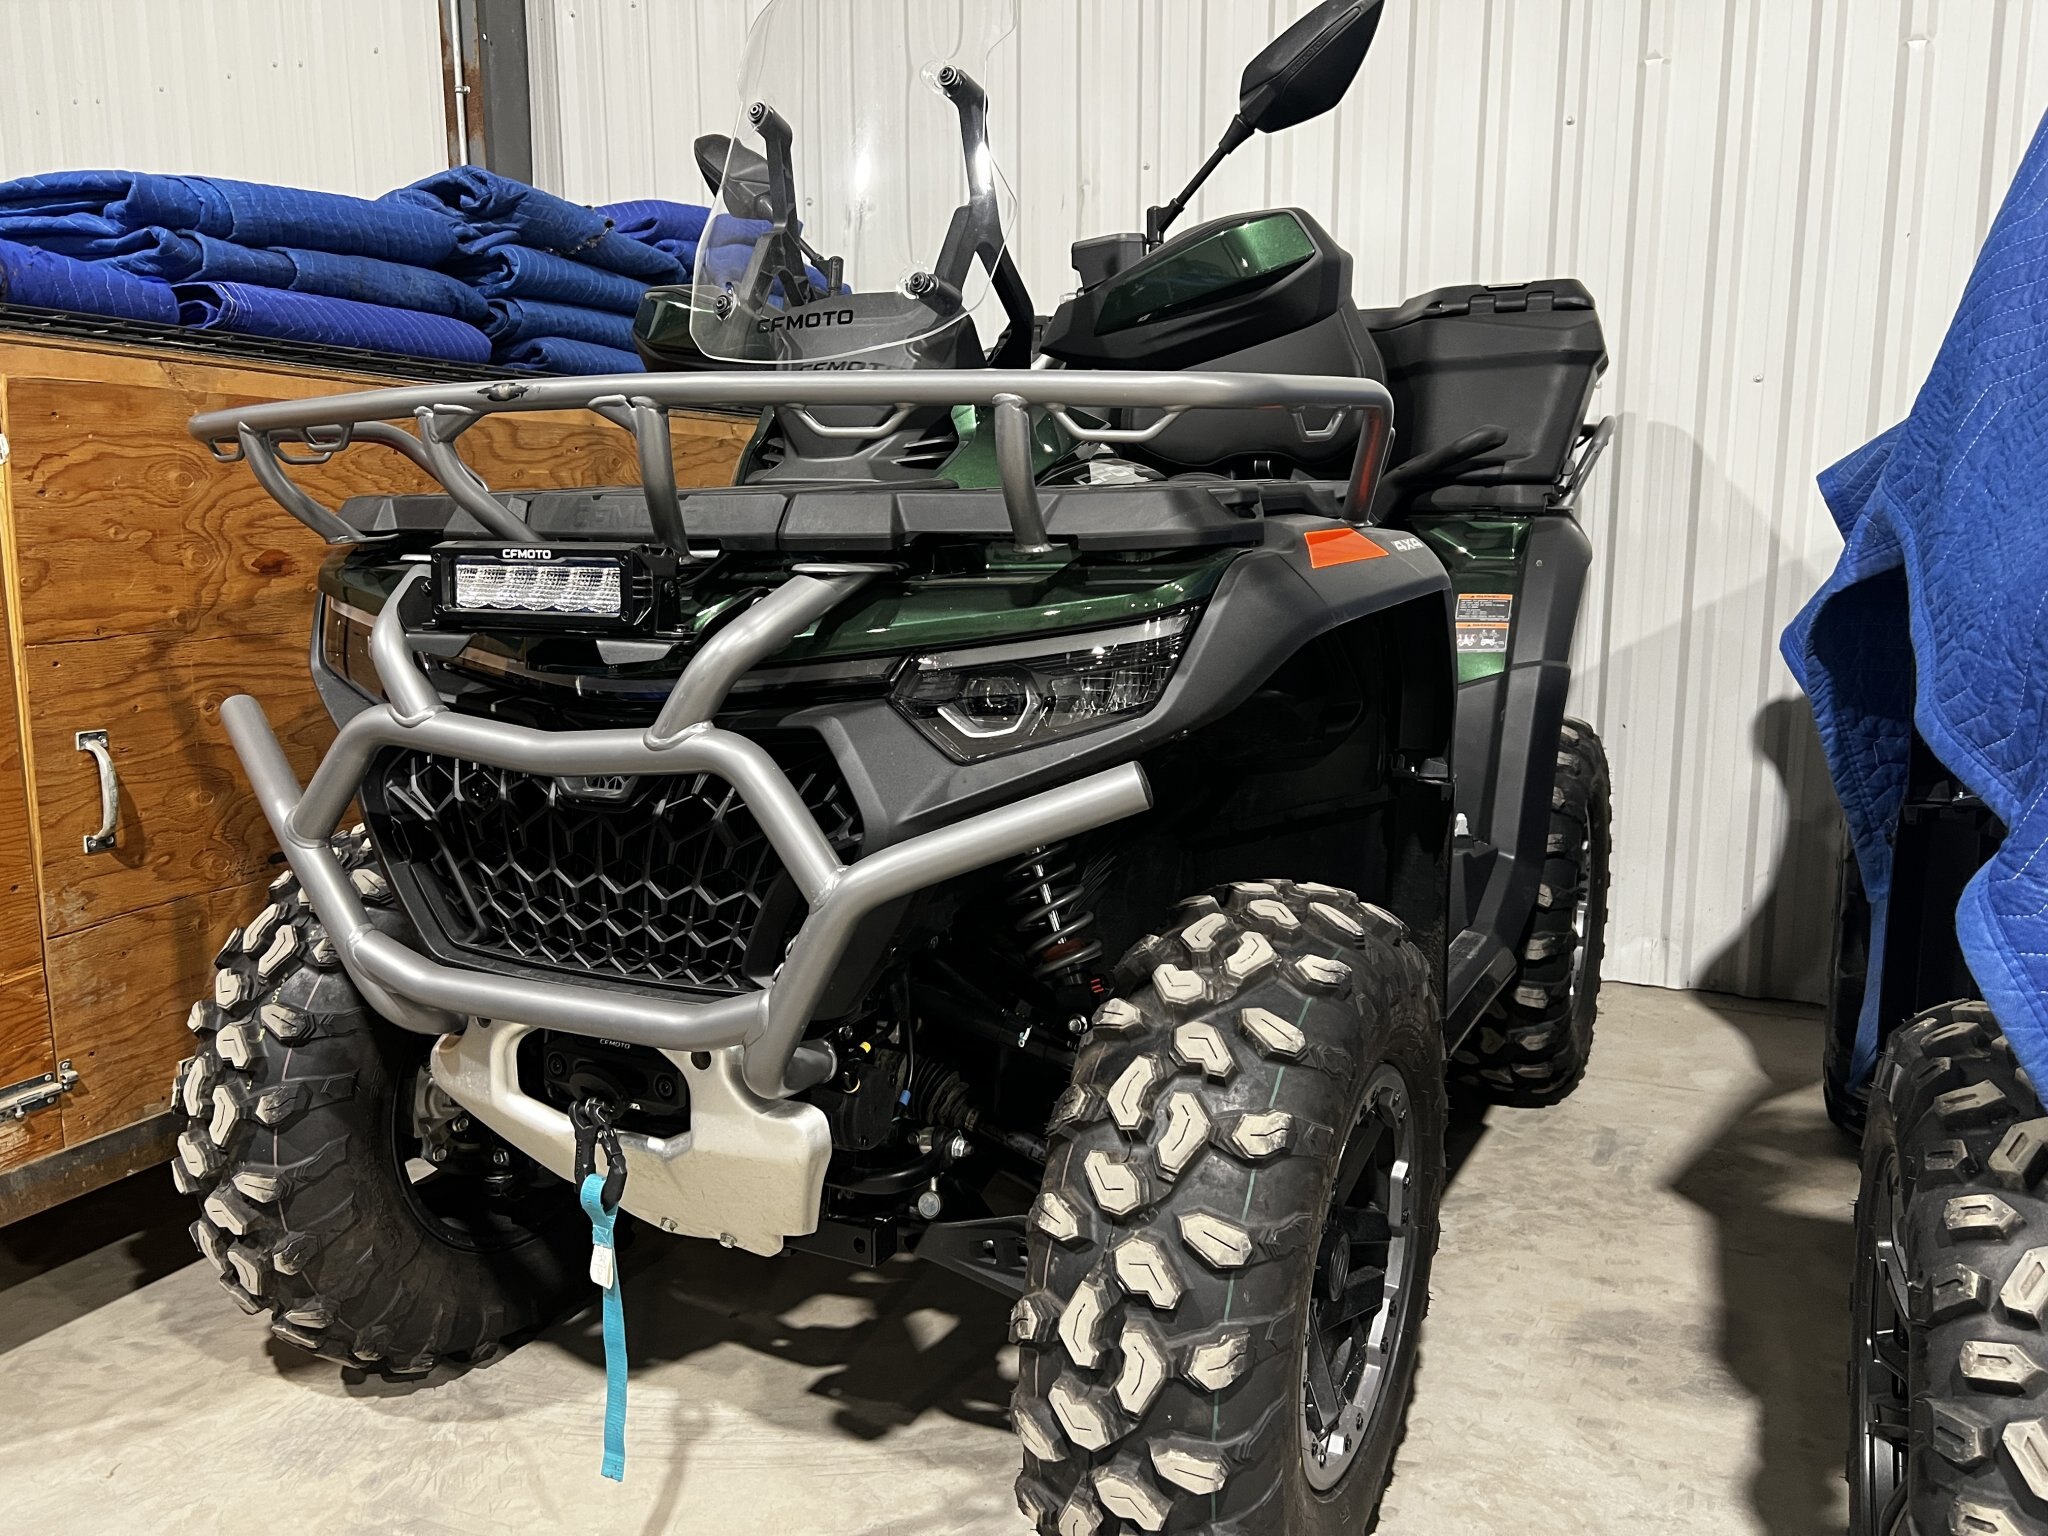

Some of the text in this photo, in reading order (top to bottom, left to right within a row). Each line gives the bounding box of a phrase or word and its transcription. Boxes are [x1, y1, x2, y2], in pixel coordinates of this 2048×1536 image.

[757, 309, 853, 333] CFMOTO
[502, 548, 551, 559] CFMOTO
[600, 1038, 631, 1050] CFMOTO
